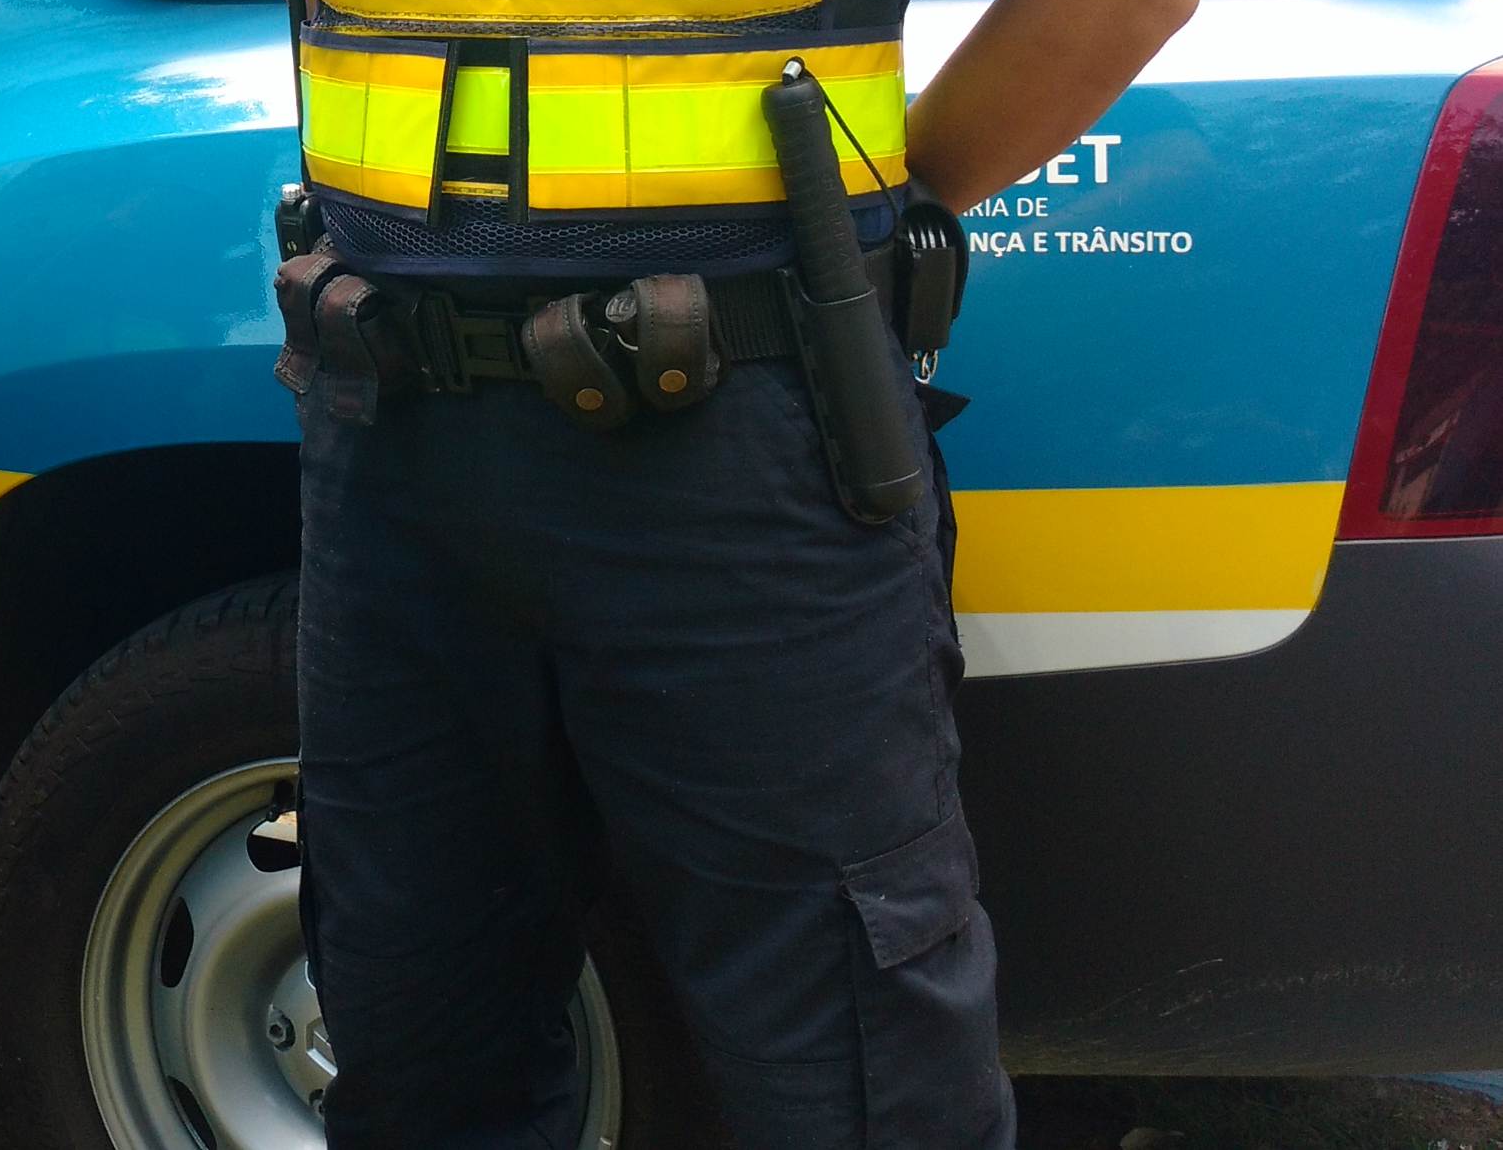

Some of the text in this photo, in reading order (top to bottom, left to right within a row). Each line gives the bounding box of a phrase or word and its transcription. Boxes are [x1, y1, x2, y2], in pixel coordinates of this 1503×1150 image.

[1014, 134, 1121, 184] ET
[962, 197, 1049, 217] RIA DE
[969, 226, 1193, 257] NÇA E TRÂNSITO
